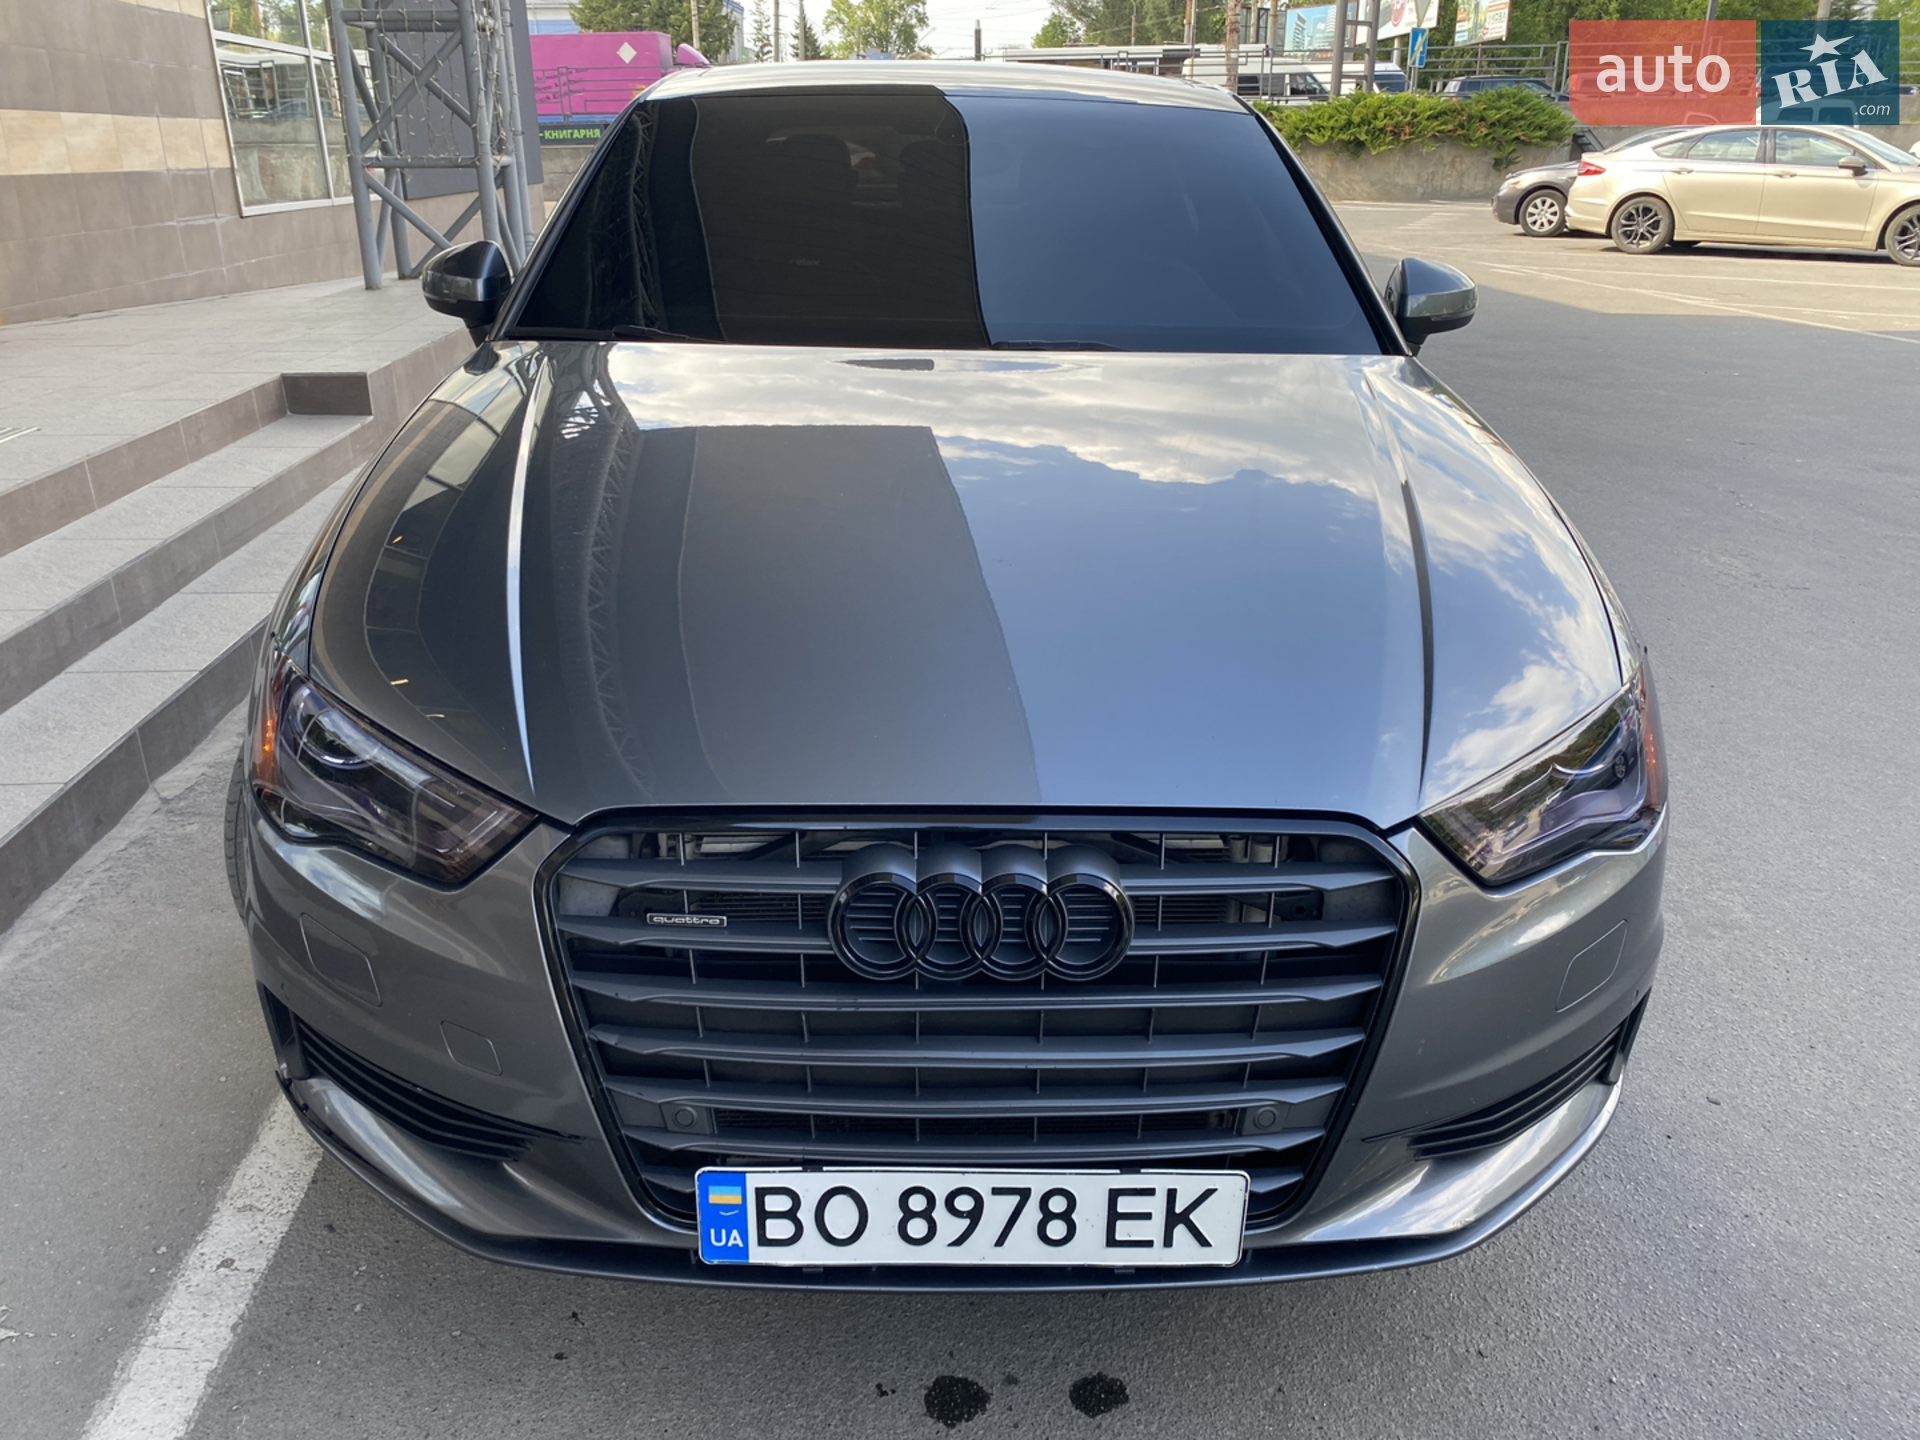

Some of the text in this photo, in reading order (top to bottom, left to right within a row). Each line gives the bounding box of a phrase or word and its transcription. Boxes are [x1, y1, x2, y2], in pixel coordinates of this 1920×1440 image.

[652, 916, 721, 925] quattro
[754, 1185, 1218, 1249] BO 8978 EK
[710, 1228, 744, 1248] UA
